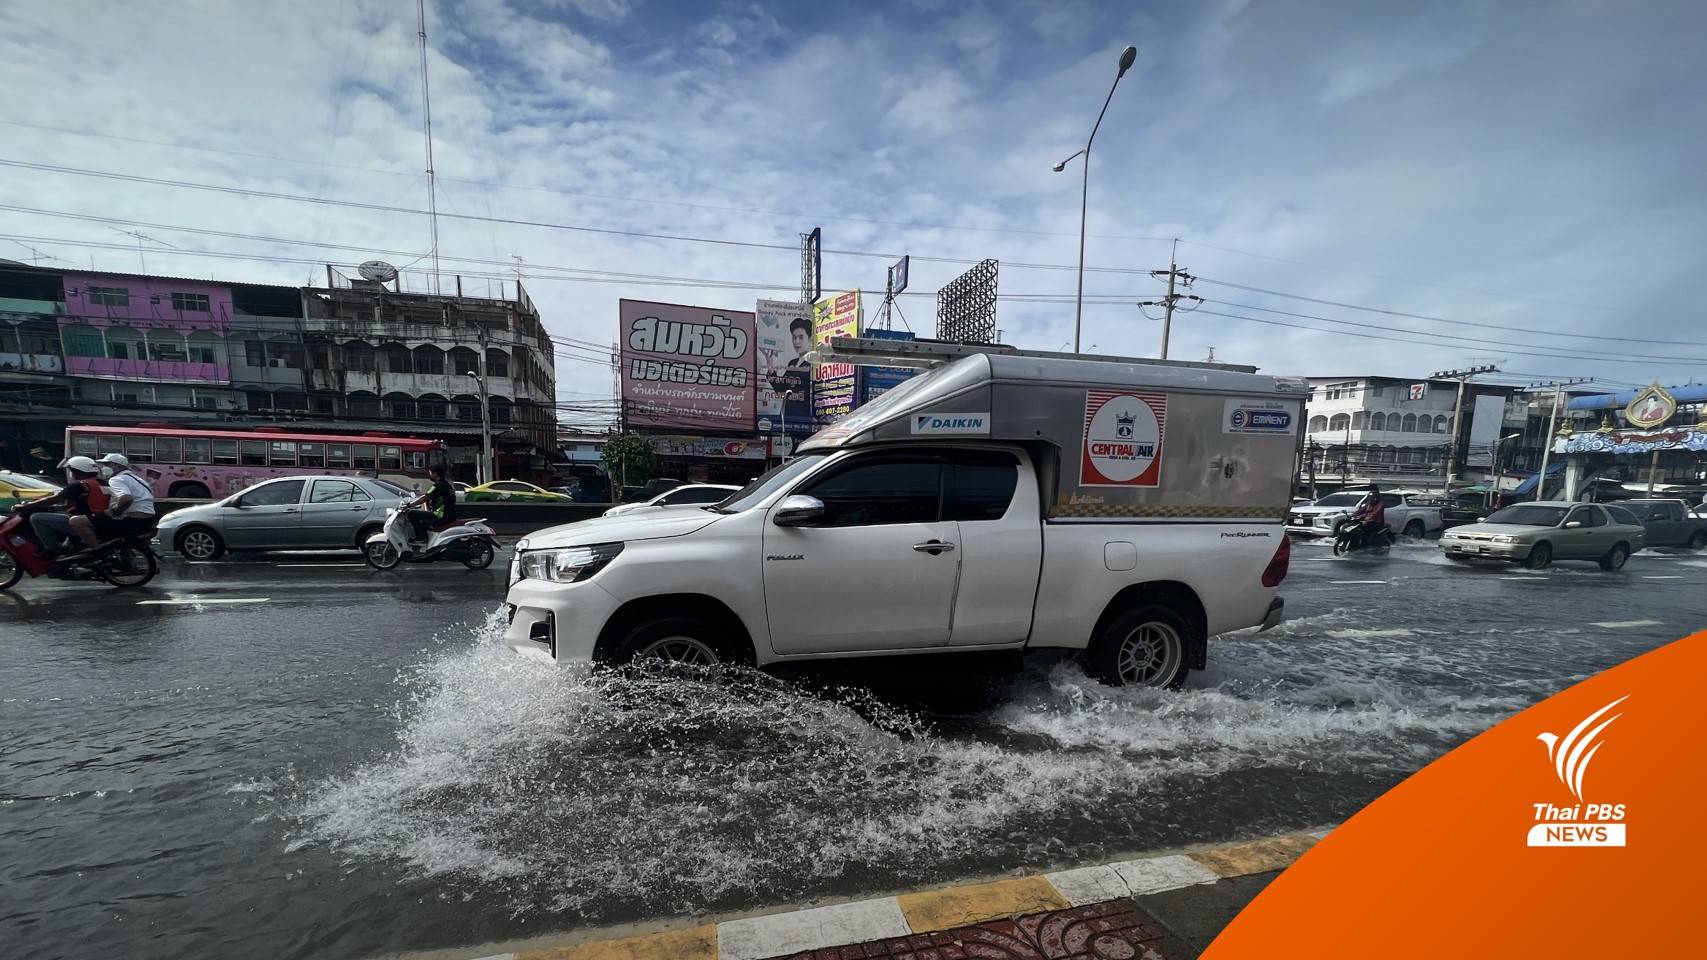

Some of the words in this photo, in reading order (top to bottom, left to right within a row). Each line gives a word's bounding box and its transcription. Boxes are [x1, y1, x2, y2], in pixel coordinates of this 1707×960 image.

[629, 315, 747, 359] สมหวัง
[932, 418, 983, 428] DAIKIN
[1091, 443, 1134, 456] CENTRAL
[1137, 445, 1154, 457] AIR
